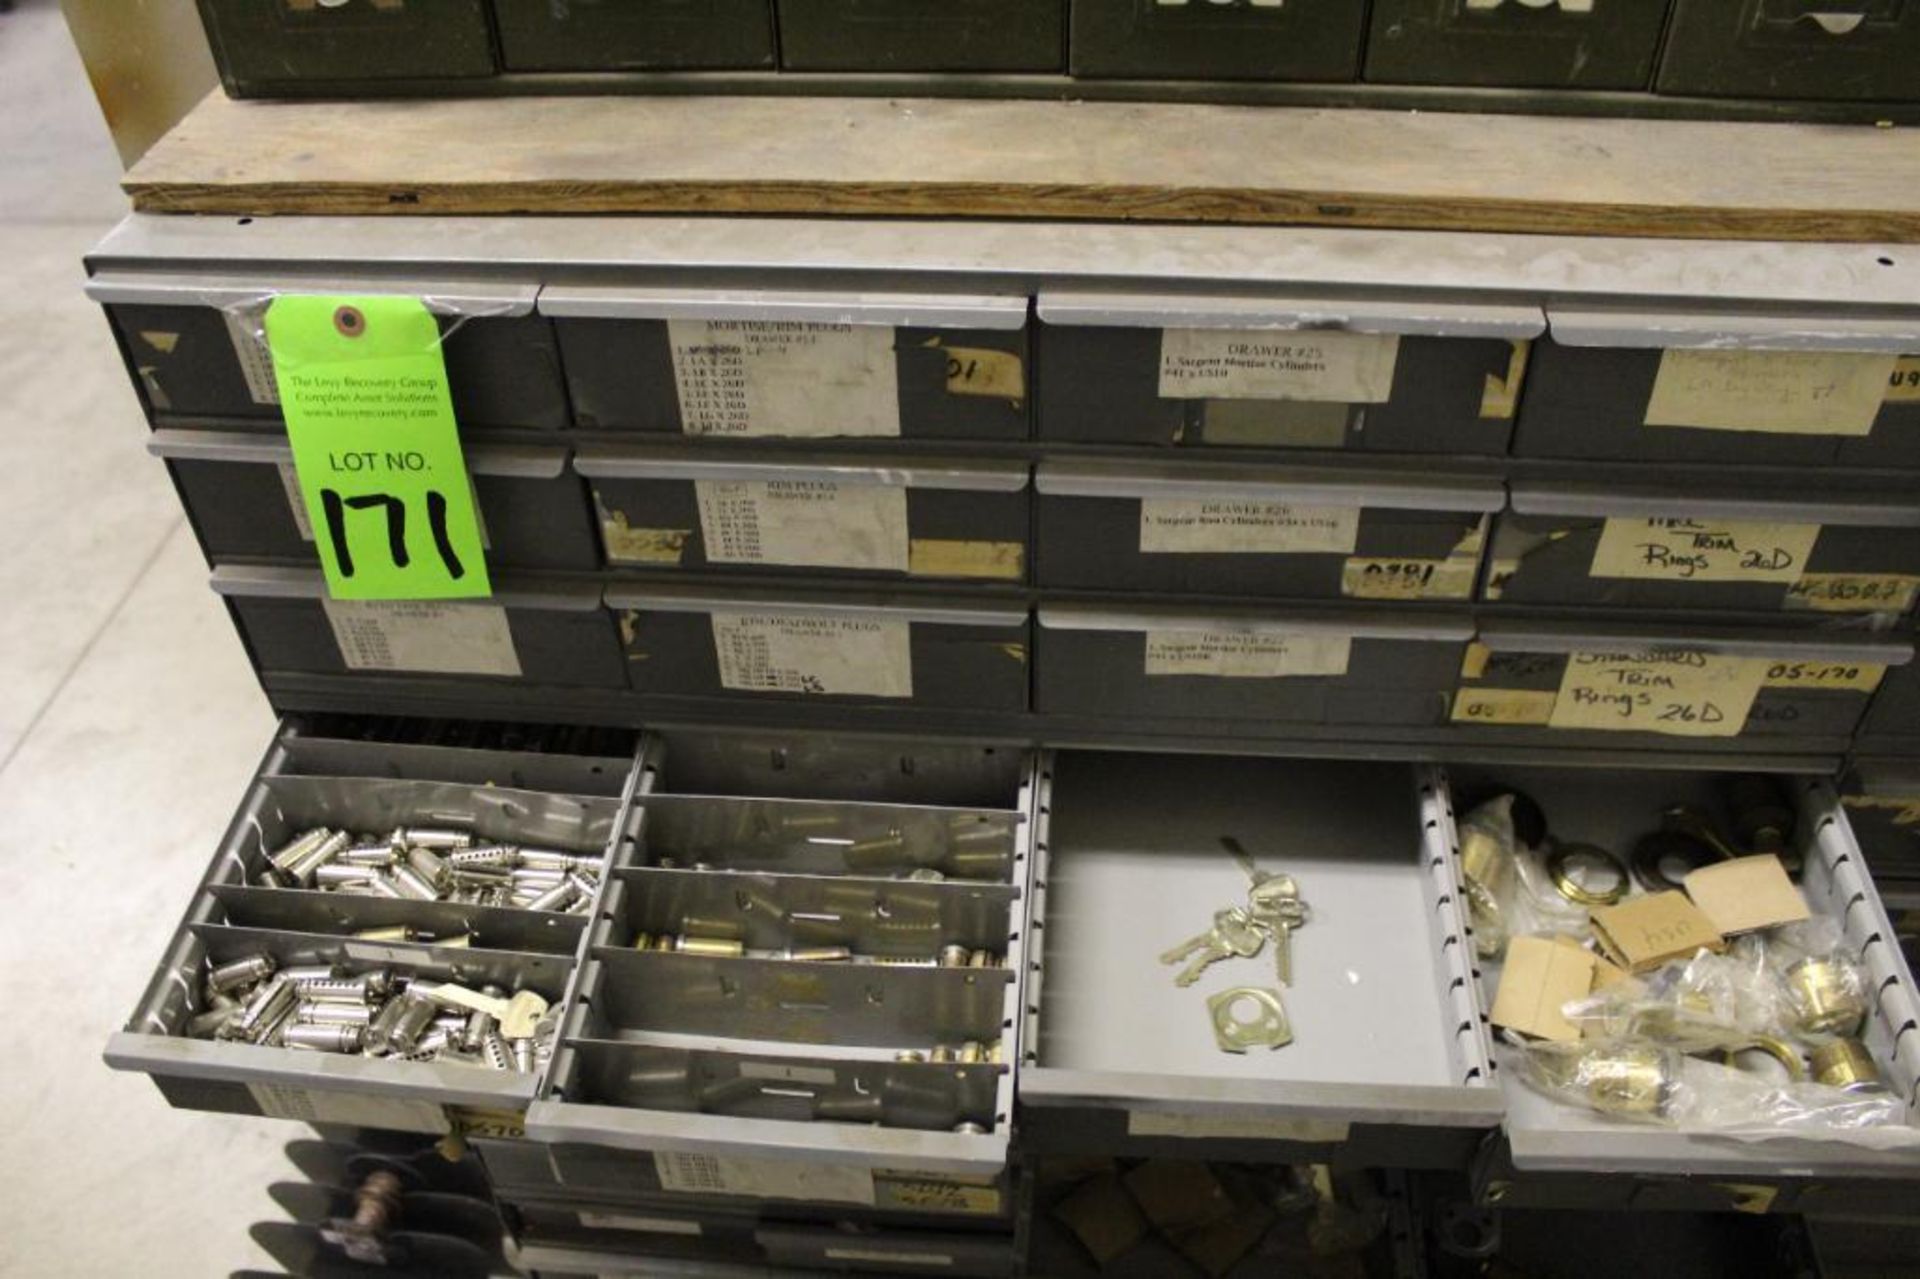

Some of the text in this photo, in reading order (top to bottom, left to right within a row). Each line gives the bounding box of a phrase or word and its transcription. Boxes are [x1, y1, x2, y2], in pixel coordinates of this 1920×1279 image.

[1228, 344, 1291, 357] DRAWER
[400, 377, 438, 390] Group
[329, 452, 432, 471] LOT NO.
[320, 488, 465, 580] 171
[1657, 702, 1724, 722] 26D
